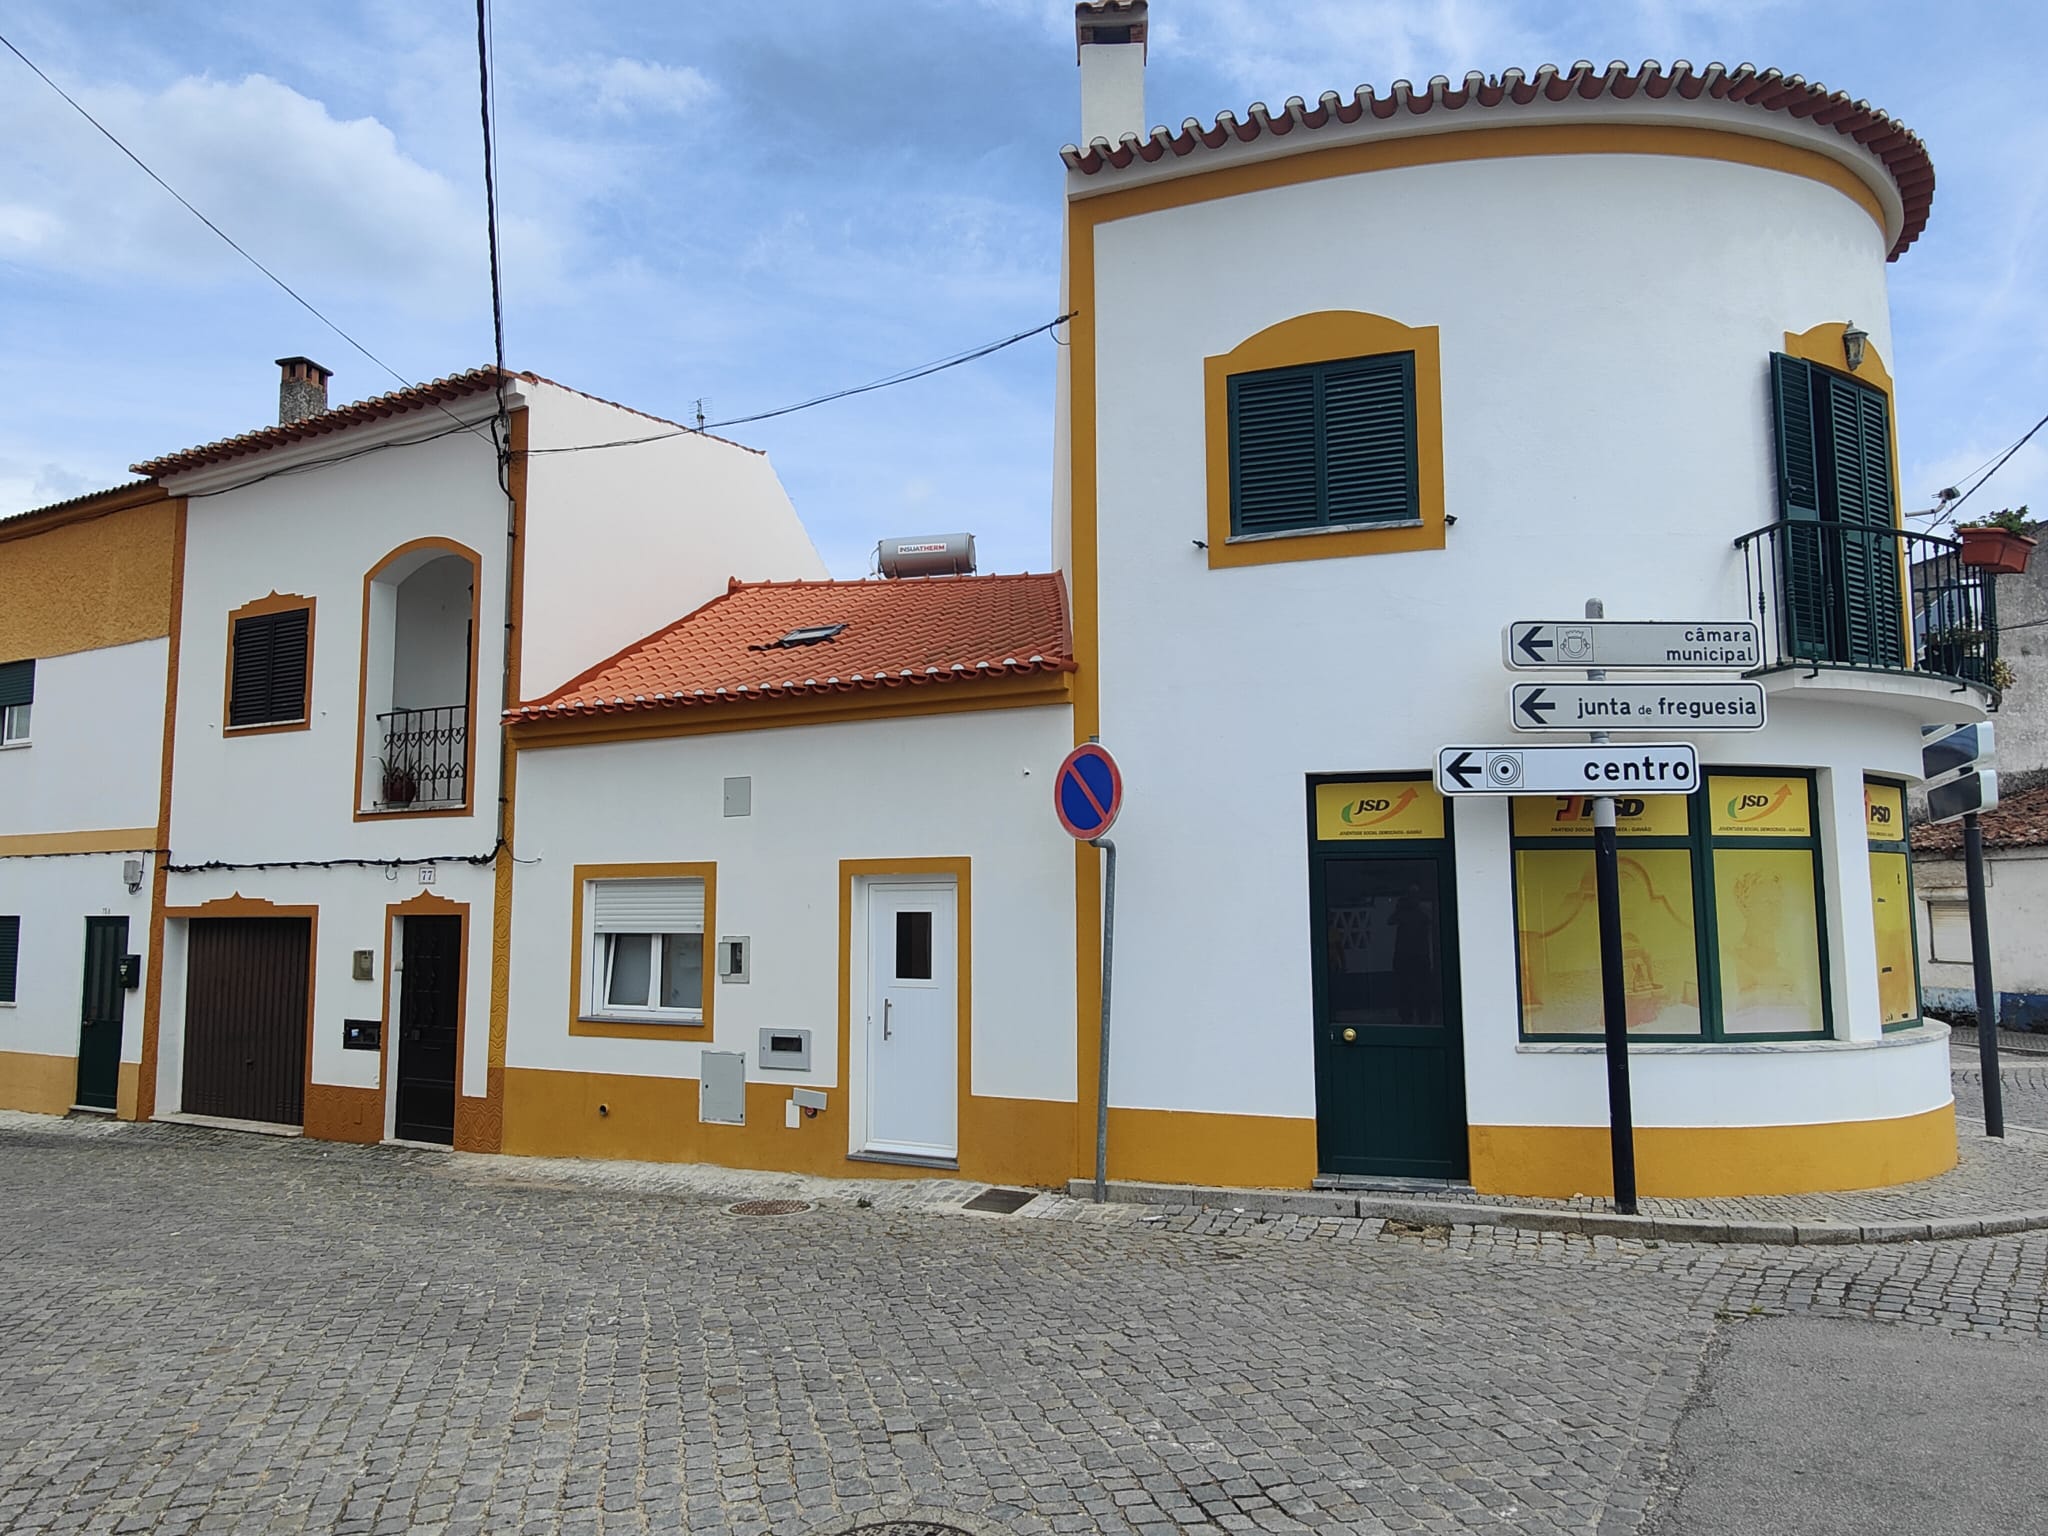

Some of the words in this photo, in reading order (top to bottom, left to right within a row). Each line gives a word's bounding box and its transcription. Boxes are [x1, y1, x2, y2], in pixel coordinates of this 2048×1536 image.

[1684, 627, 1751, 642] câmara
[1666, 646, 1752, 663] municipal
[1577, 697, 1631, 719] junta
[1638, 704, 1652, 715] de
[1658, 697, 1756, 718] freguesia
[1583, 755, 1689, 781] centro
[1354, 799, 1390, 815] JSD
[1738, 794, 1768, 810] JSD
[1870, 804, 1890, 823] PSD
[422, 870, 433, 881] 77
